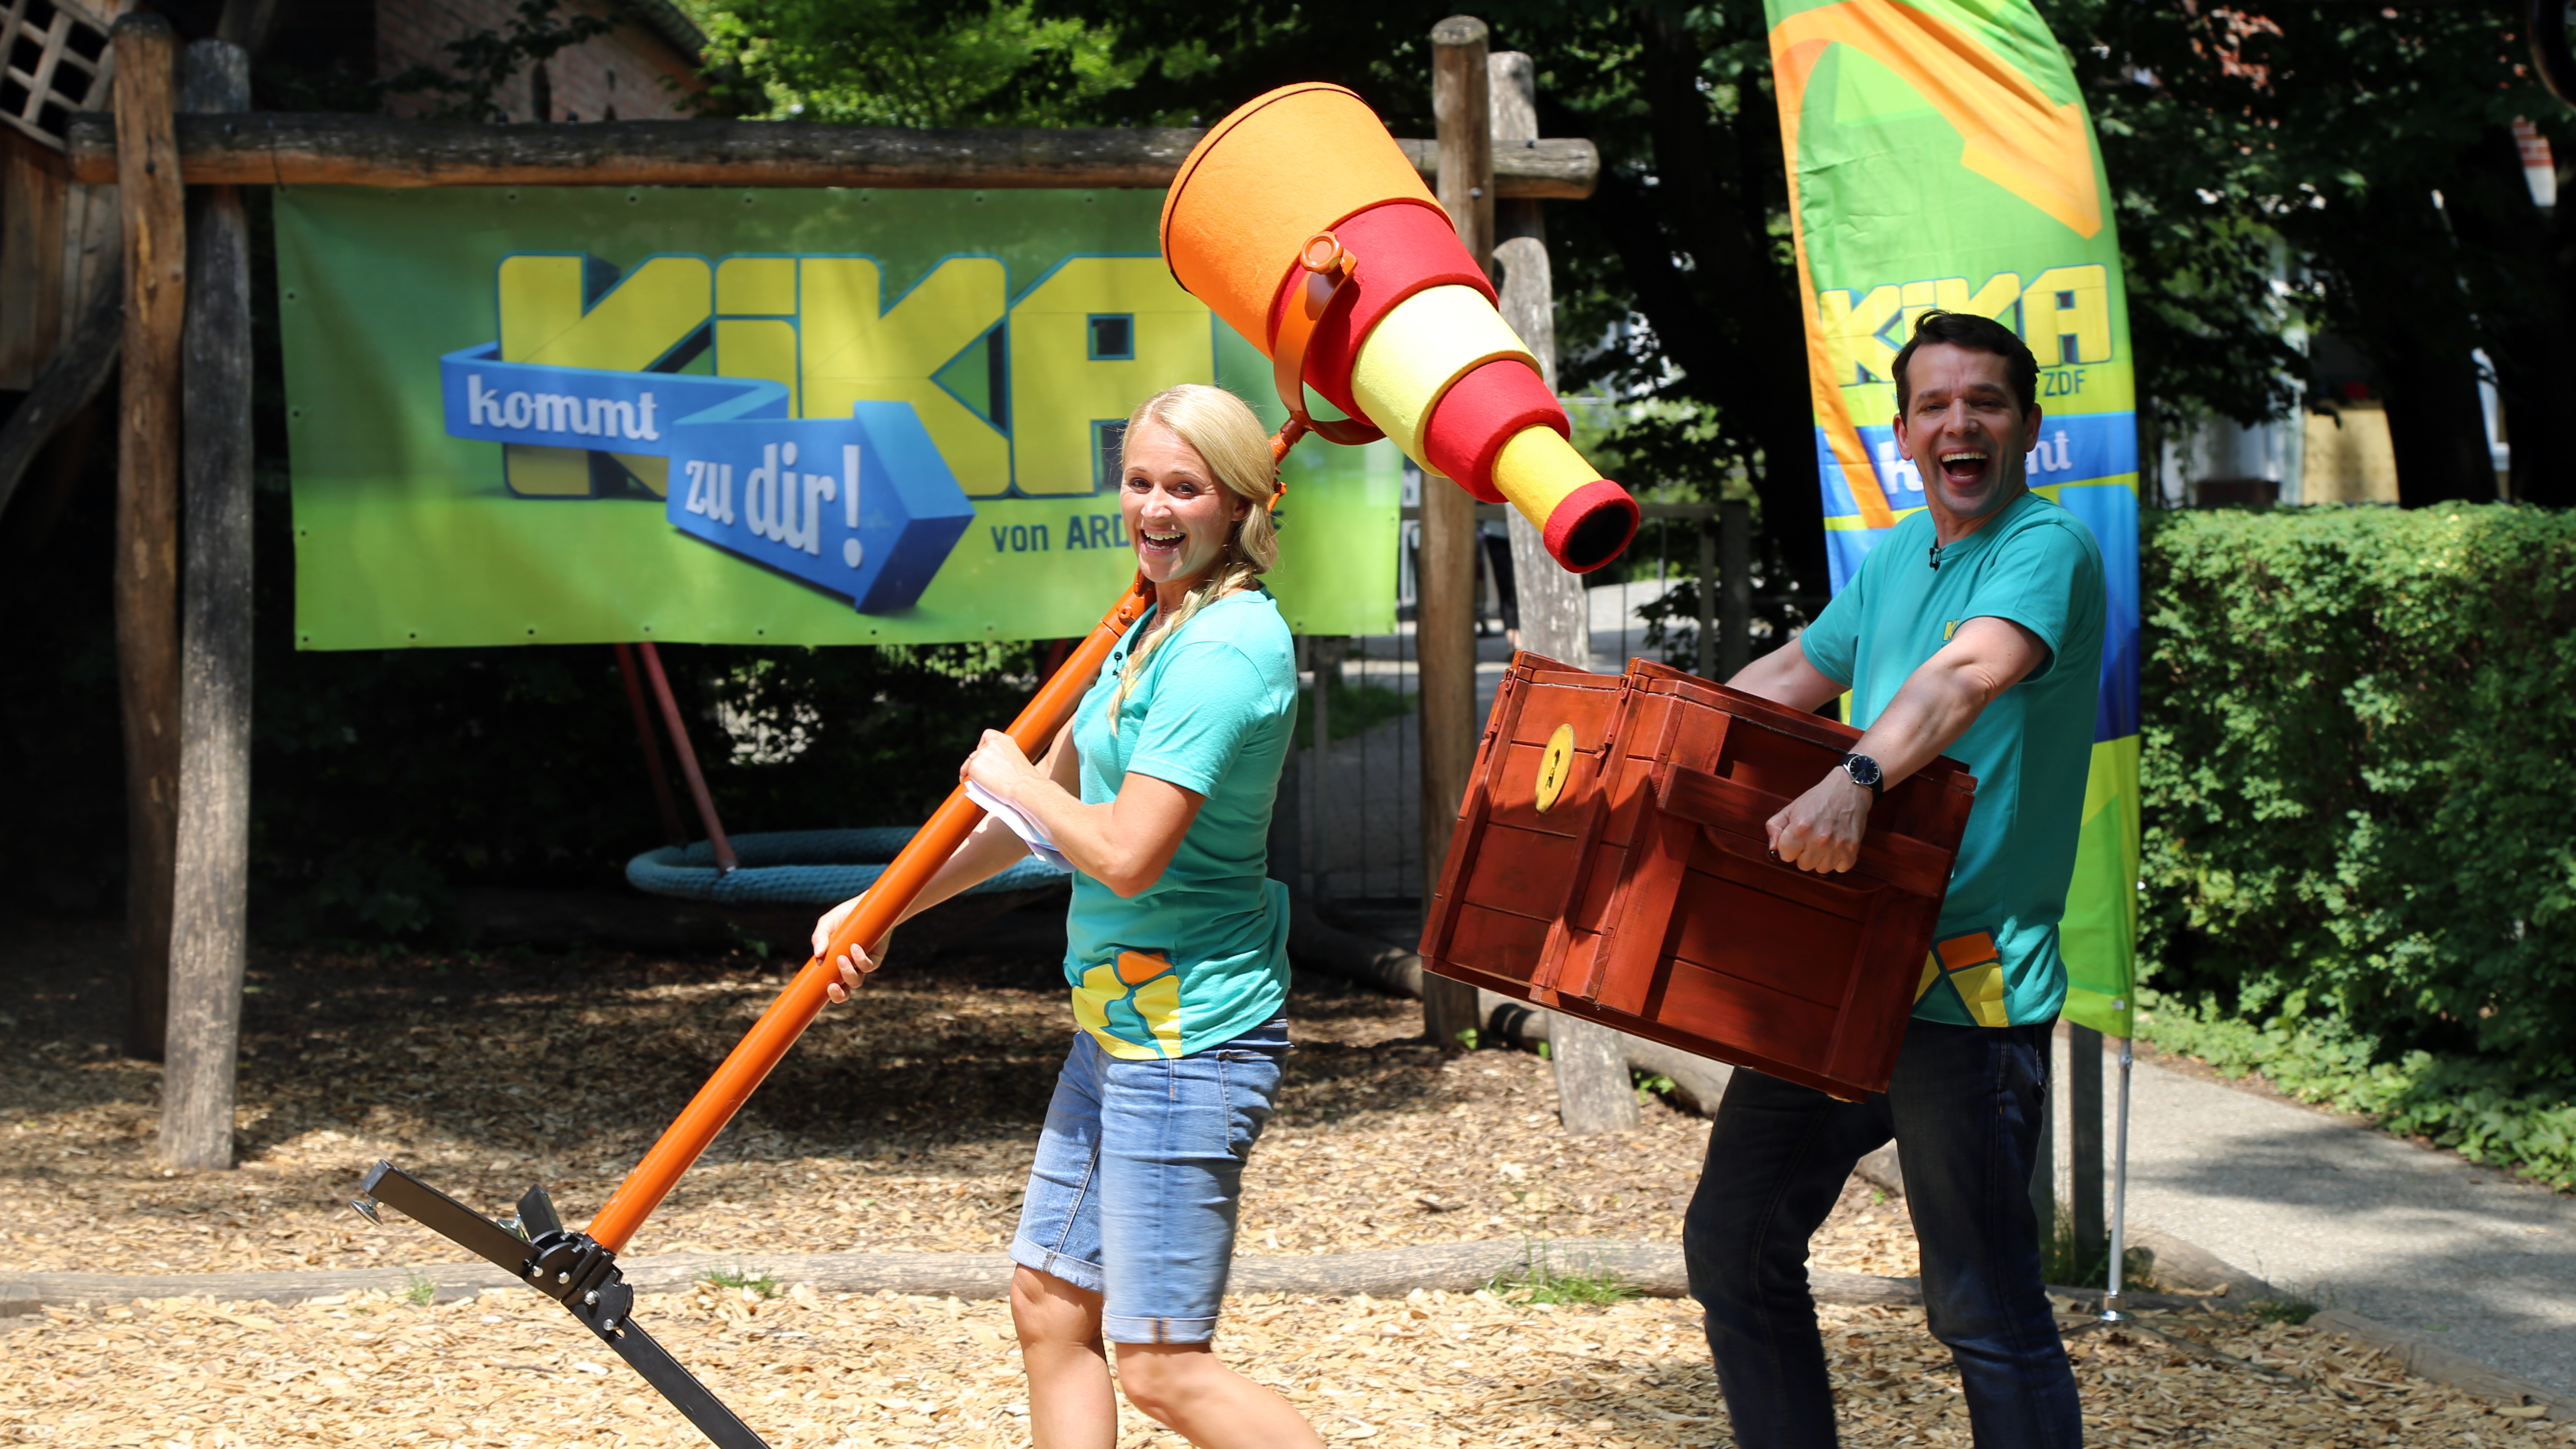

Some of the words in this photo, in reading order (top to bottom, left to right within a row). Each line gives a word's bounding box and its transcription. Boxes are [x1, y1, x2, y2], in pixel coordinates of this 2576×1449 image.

[467, 373, 660, 442] kommt
[2043, 369, 2086, 397] ZDF
[685, 459, 735, 526] zu
[745, 441, 863, 569] dir!
[990, 523, 1049, 553] von
